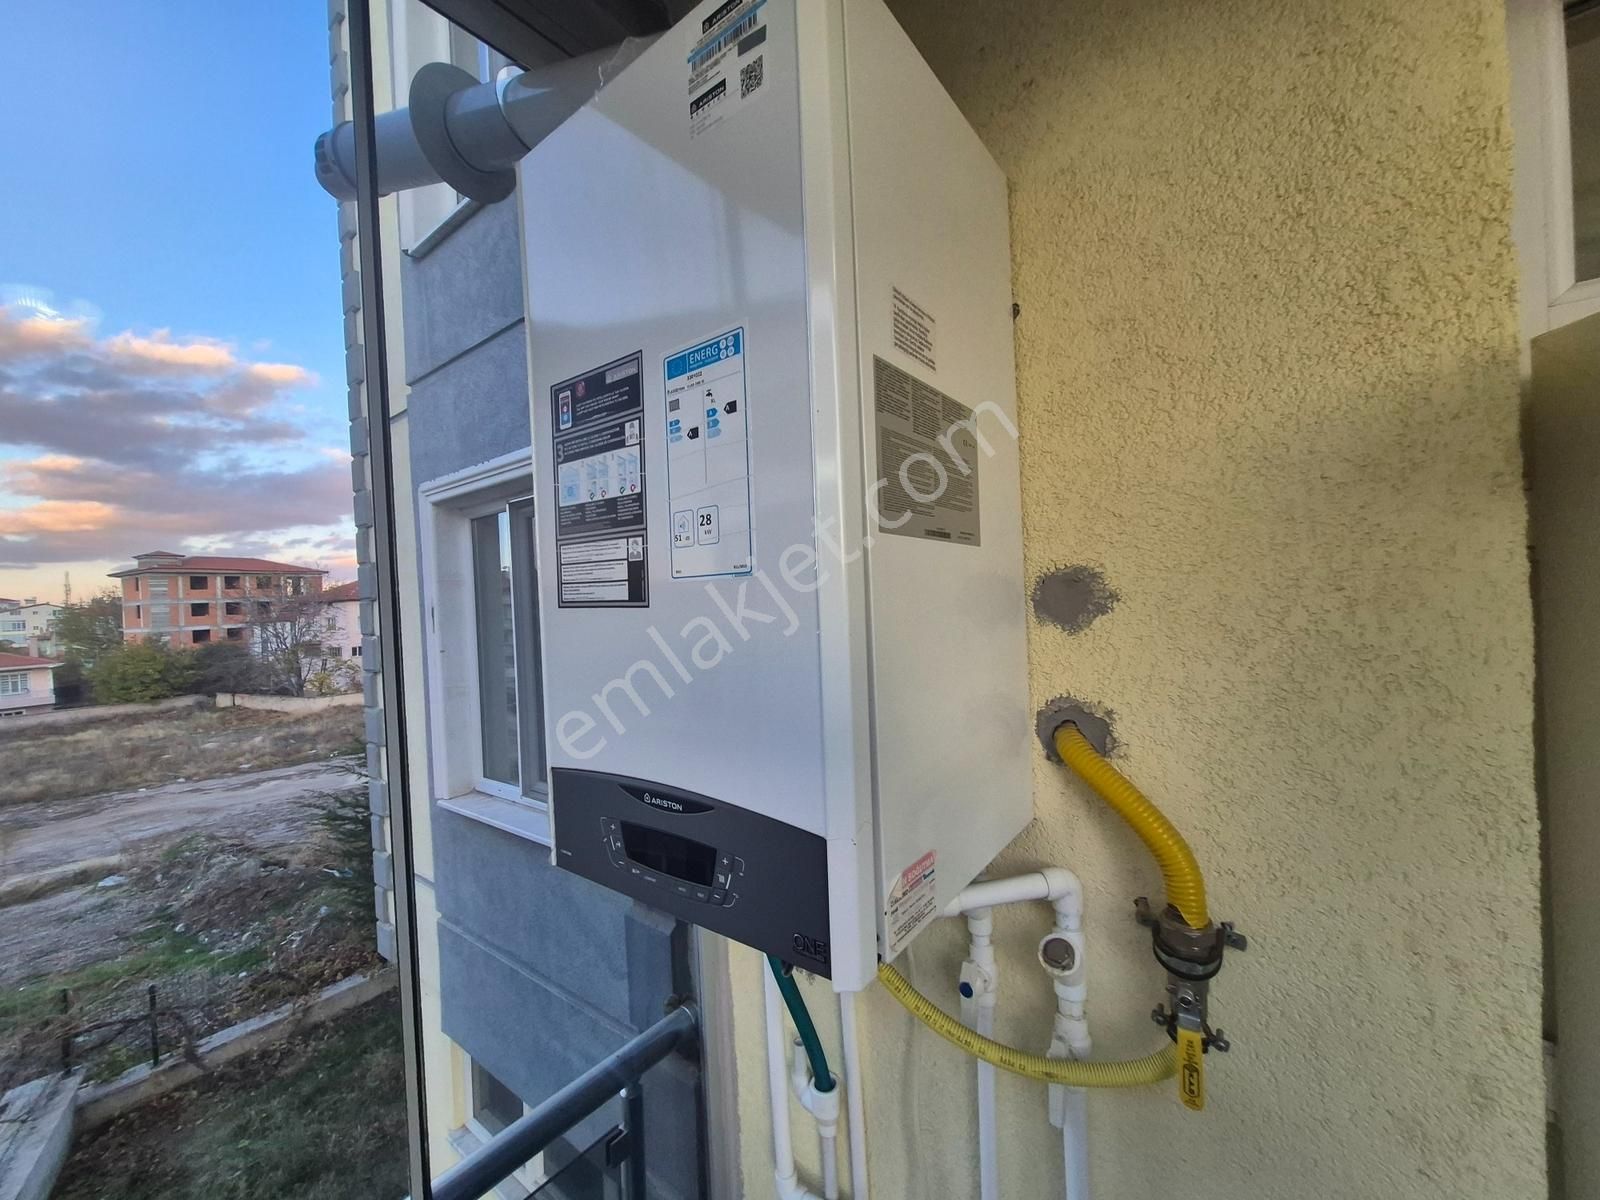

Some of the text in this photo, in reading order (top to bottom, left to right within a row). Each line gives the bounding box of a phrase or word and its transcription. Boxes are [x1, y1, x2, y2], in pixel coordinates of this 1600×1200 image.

[689, 344, 719, 365] ENERG
[557, 444, 564, 462] 3
[699, 513, 712, 527] 28
[674, 534, 682, 542] 51
[651, 796, 683, 812] ARISTON
[793, 933, 825, 960] ONE
